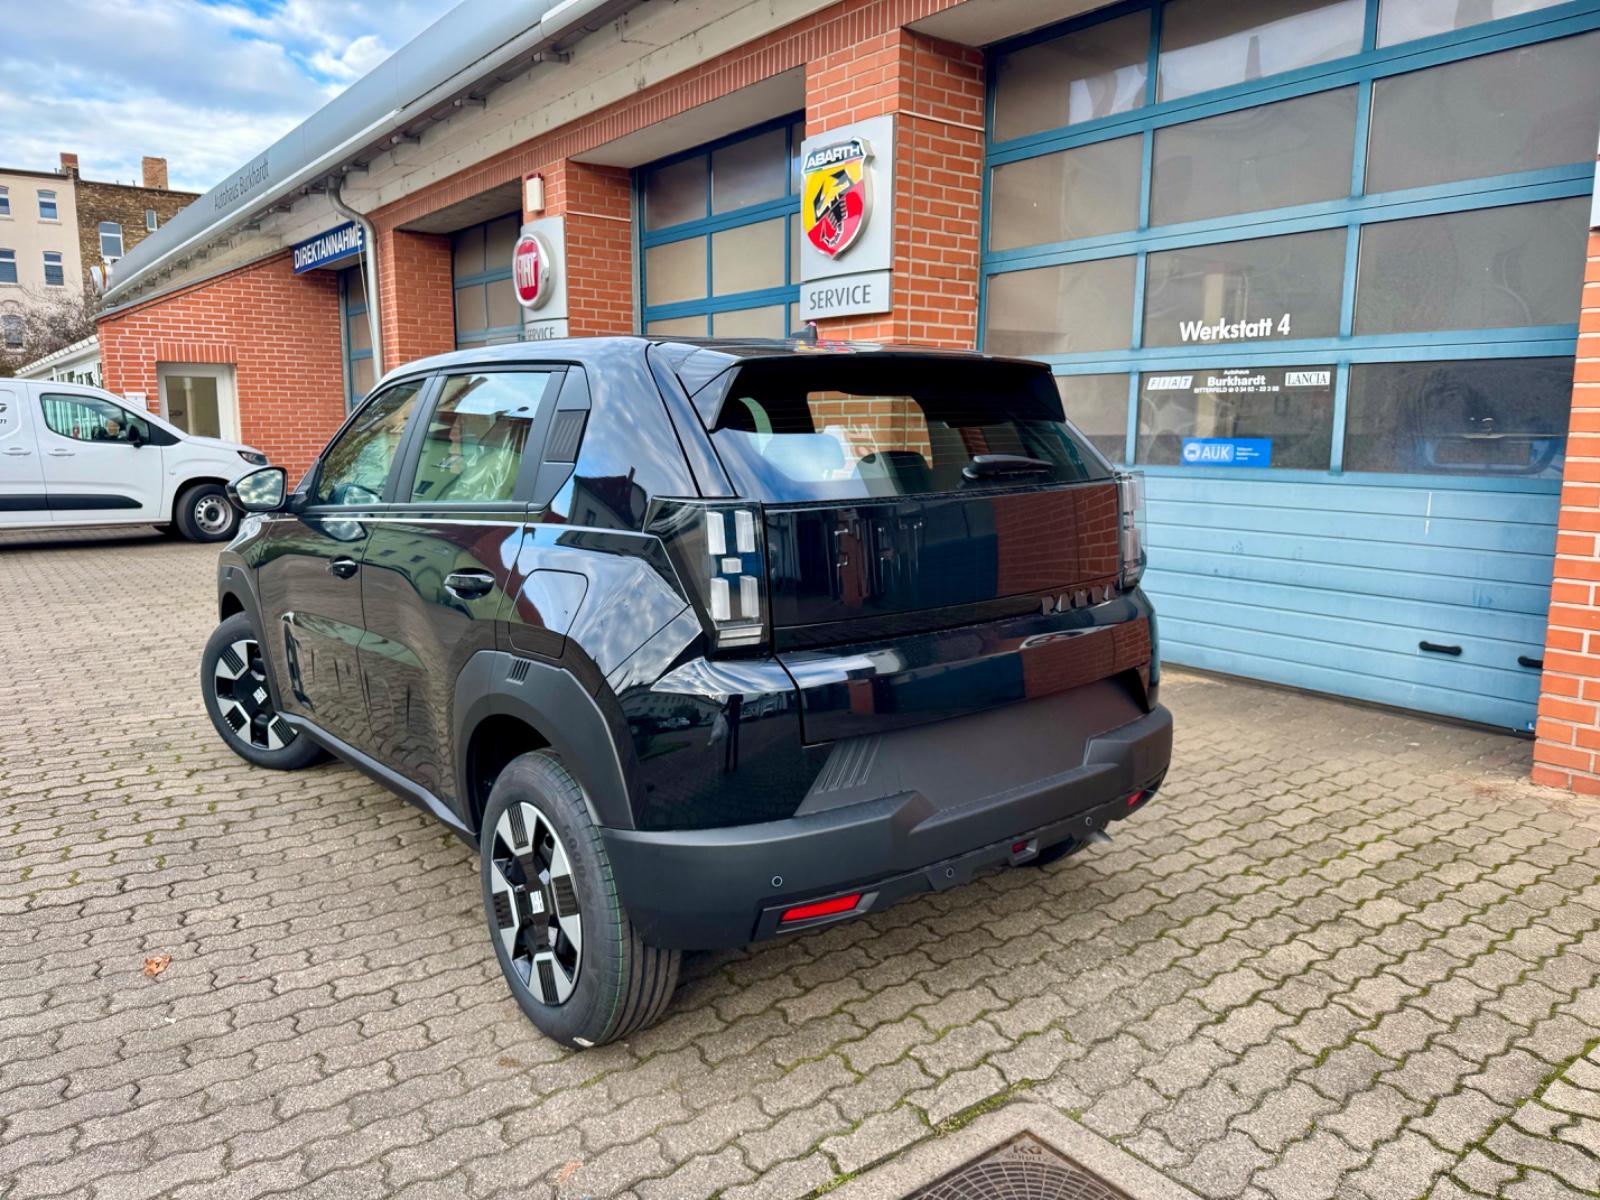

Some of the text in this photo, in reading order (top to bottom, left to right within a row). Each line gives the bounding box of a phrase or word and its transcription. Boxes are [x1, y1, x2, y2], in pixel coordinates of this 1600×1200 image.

[807, 145, 861, 169] ABARTH
[214, 158, 270, 213] Autohaus Burkhardt
[294, 224, 363, 270] DIREKTANNAHME
[517, 251, 537, 288] FIAT
[809, 284, 872, 311] SERVICE
[1179, 313, 1291, 342] Werkstatt 4
[1148, 375, 1193, 390] FIAT
[1207, 375, 1266, 387] Burkhardt
[1287, 373, 1328, 386] LANCIA
[1201, 446, 1231, 460] AUK
